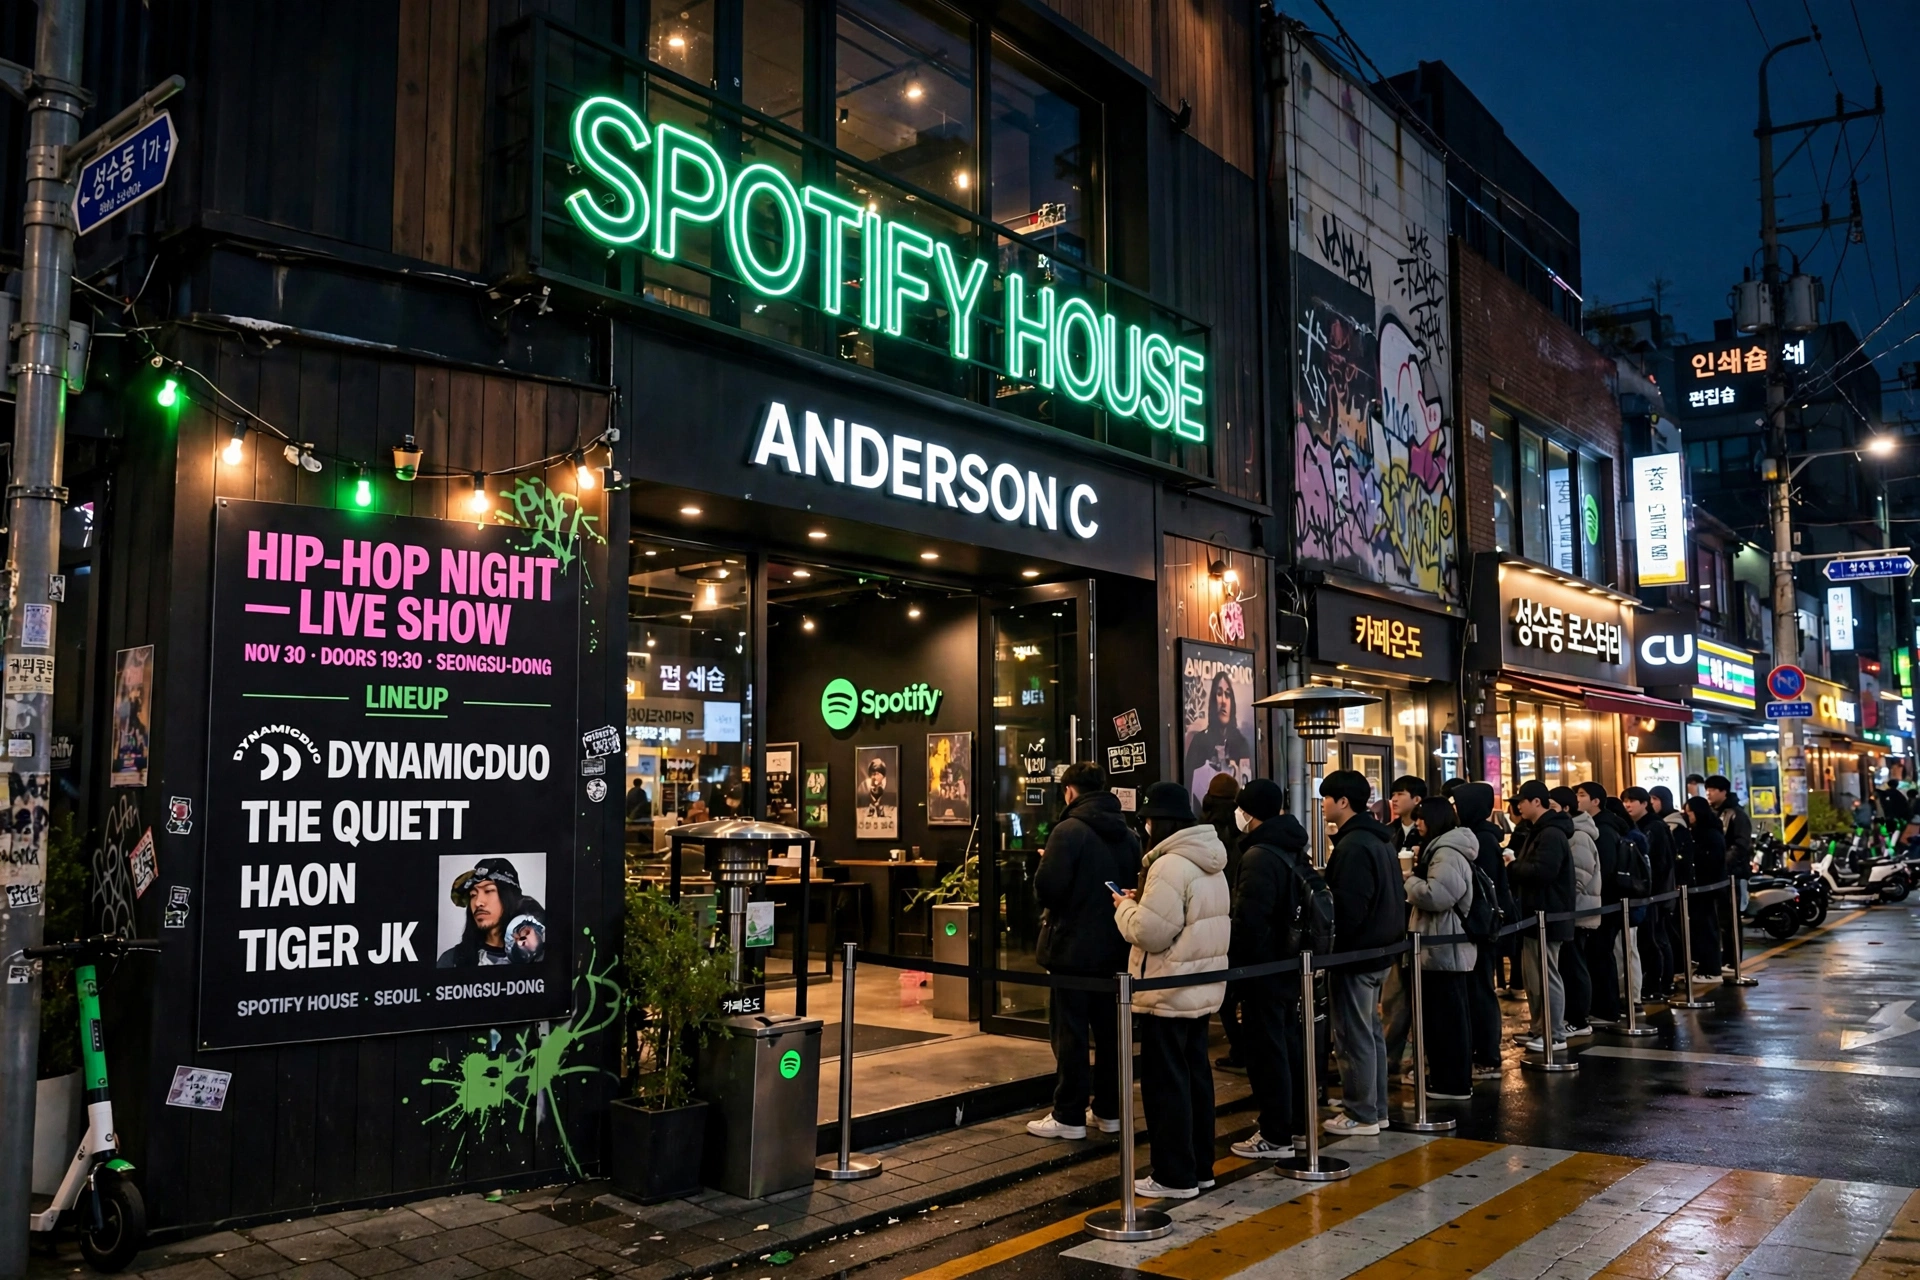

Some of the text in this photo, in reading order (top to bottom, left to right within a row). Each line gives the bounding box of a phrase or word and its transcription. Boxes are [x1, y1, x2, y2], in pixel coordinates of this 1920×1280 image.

[93, 144, 135, 200] 성수동
[142, 134, 161, 171] 1가
[565, 95, 988, 359] SPOTIFY
[1005, 271, 1206, 442] HOUSE
[753, 401, 1099, 539] ANDERSON C
[247, 530, 559, 602] HIP-HOP NIGHT
[299, 588, 512, 646] LIVE SHOW
[1355, 614, 1423, 659] 카페온도
[1515, 597, 1623, 665] 성수동 로스터리
[244, 643, 552, 676] NOV 30 DOORS 19:30 SEONGSU-DONG
[1640, 633, 1694, 666] CU
[366, 684, 449, 710] LINEUP
[861, 682, 940, 720] Spotify
[232, 724, 322, 765] DYNAMICDUO
[327, 740, 550, 781] DYNAMICDUO
[241, 799, 470, 848] THE QUIETT
[240, 862, 356, 909] HAON
[239, 921, 419, 973] TIGER JK
[237, 978, 545, 1017] SPOTIFY HOUSE SEOUL SEONGSU-DONG
